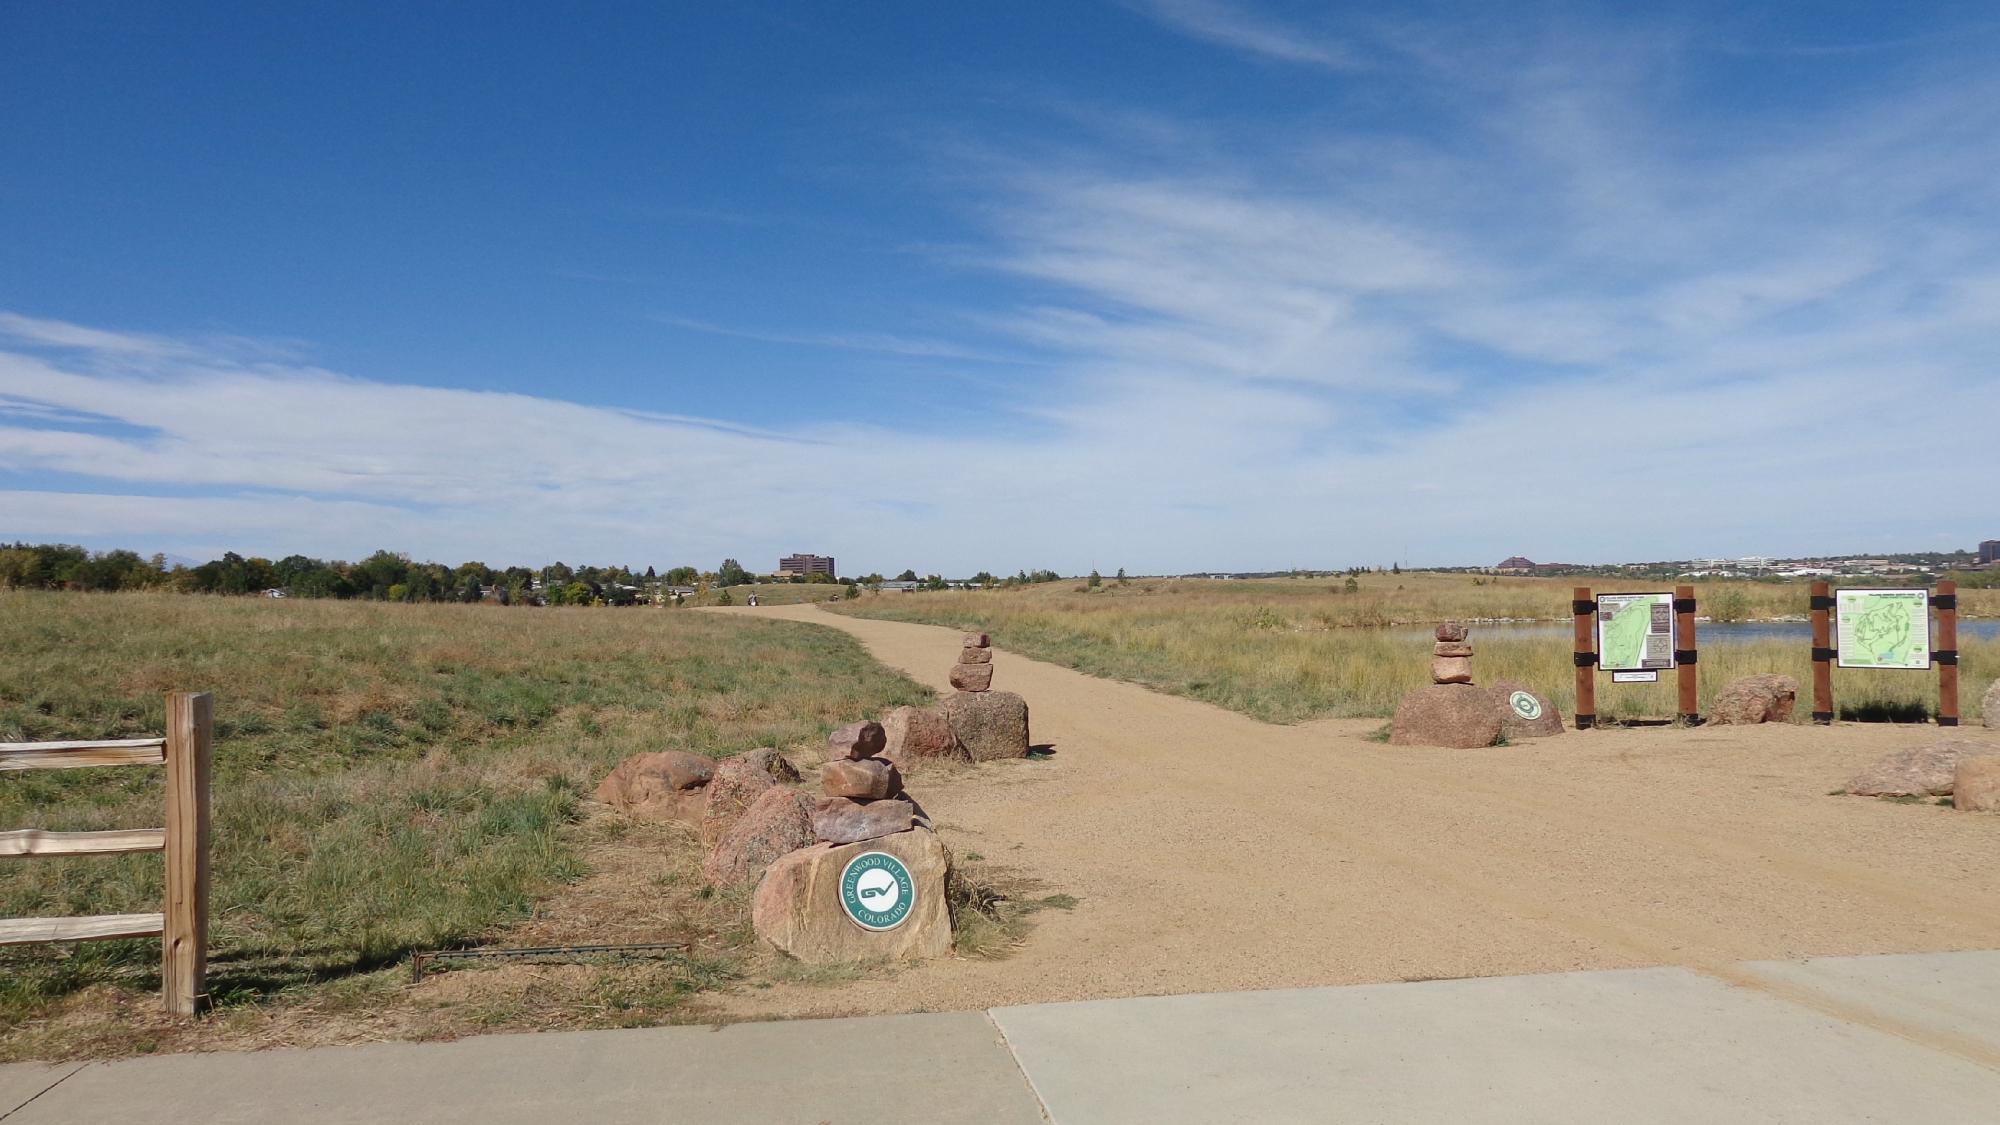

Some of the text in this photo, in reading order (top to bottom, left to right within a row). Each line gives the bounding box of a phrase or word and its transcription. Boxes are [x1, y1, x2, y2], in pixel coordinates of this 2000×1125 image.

[846, 858, 909, 904] GREENWOOD VILLAGE
[858, 902, 906, 924] COLORADO
